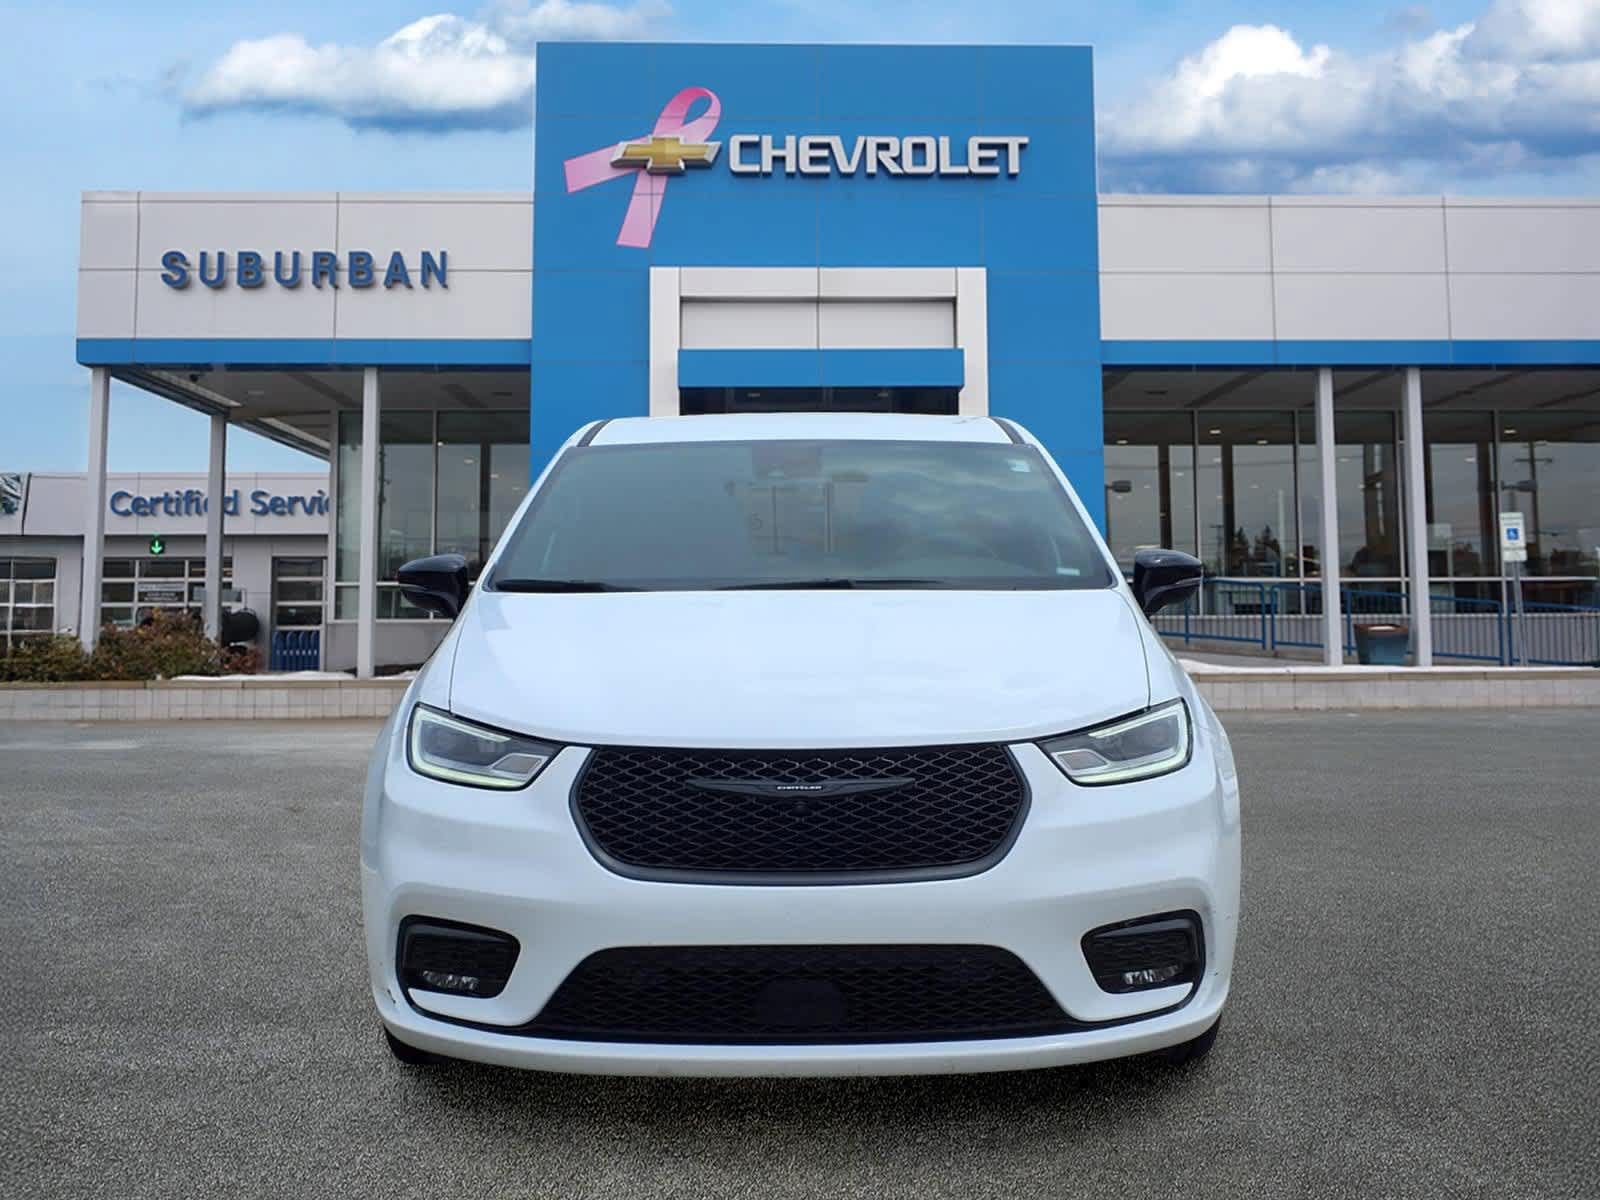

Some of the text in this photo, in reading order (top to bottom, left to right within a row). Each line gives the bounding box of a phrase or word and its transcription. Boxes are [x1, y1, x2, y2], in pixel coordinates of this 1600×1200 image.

[729, 134, 1030, 175] CHEVROLET
[161, 250, 449, 289] SUBURBAN
[110, 489, 240, 517] Certifid
